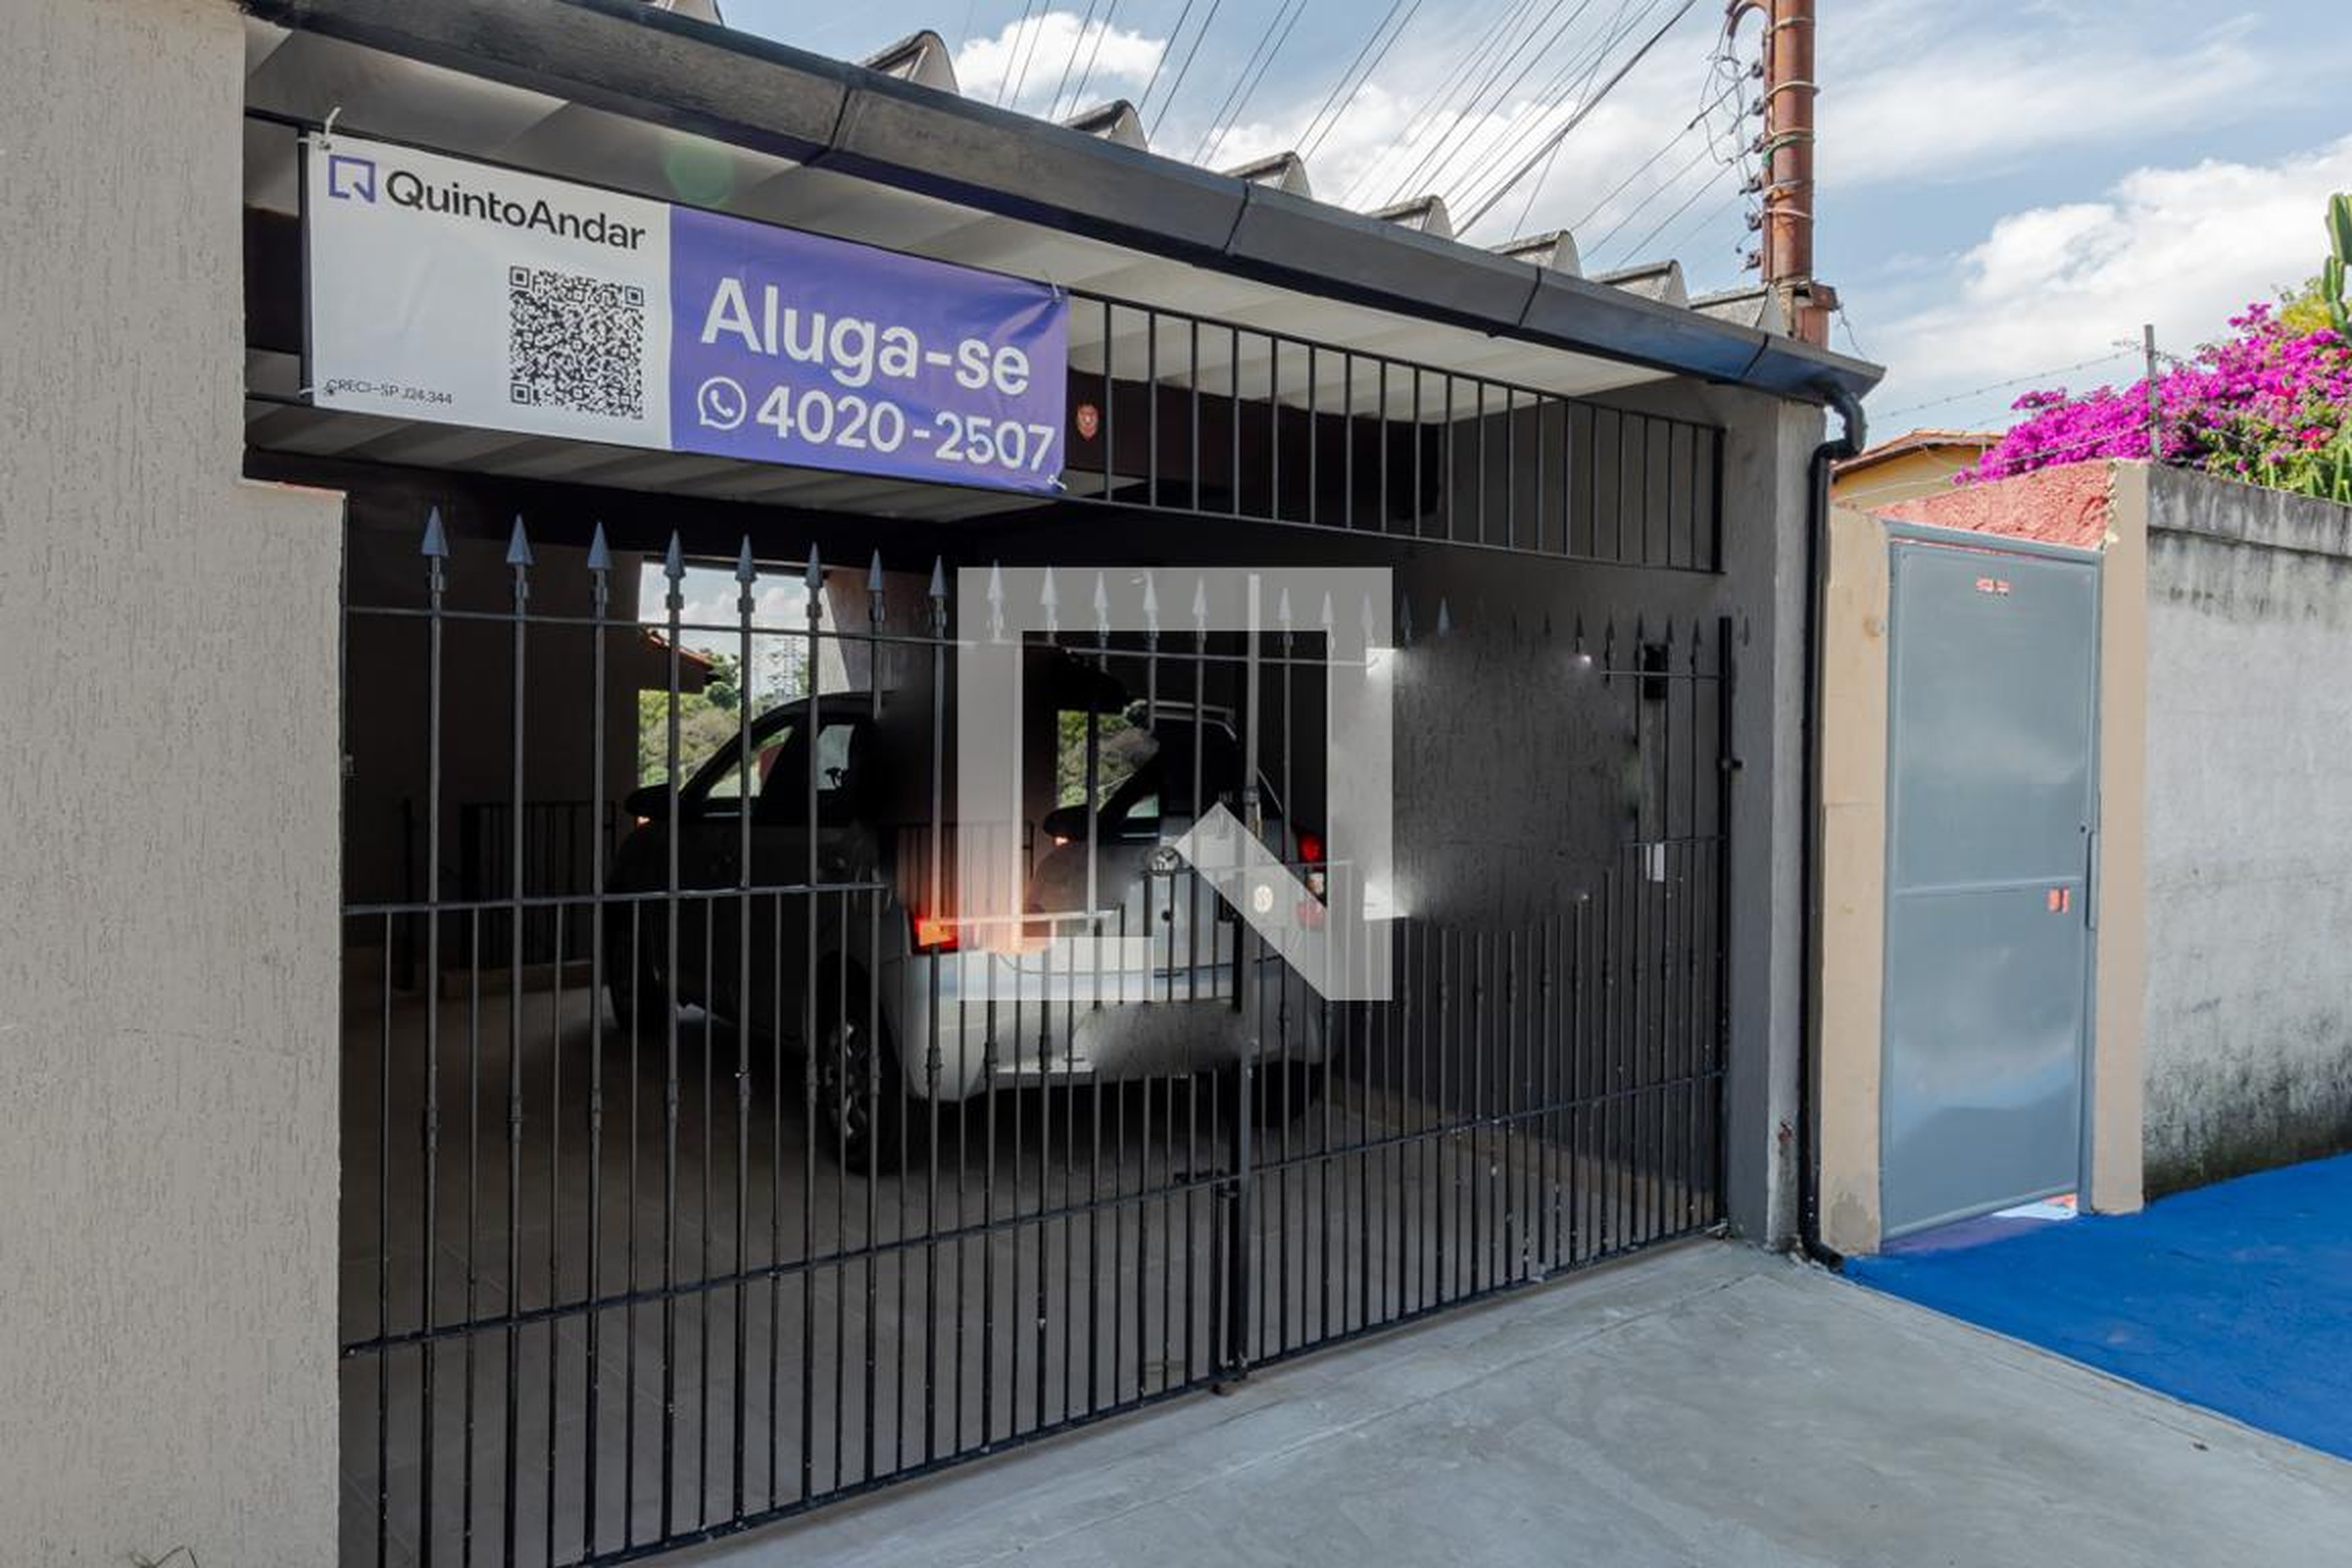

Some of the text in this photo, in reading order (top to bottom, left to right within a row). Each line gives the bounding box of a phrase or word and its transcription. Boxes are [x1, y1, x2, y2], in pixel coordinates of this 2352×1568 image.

[386, 171, 646, 249] QuintoAndar
[701, 277, 1030, 395] Aluga-se
[756, 385, 1056, 472] 4020-2507
